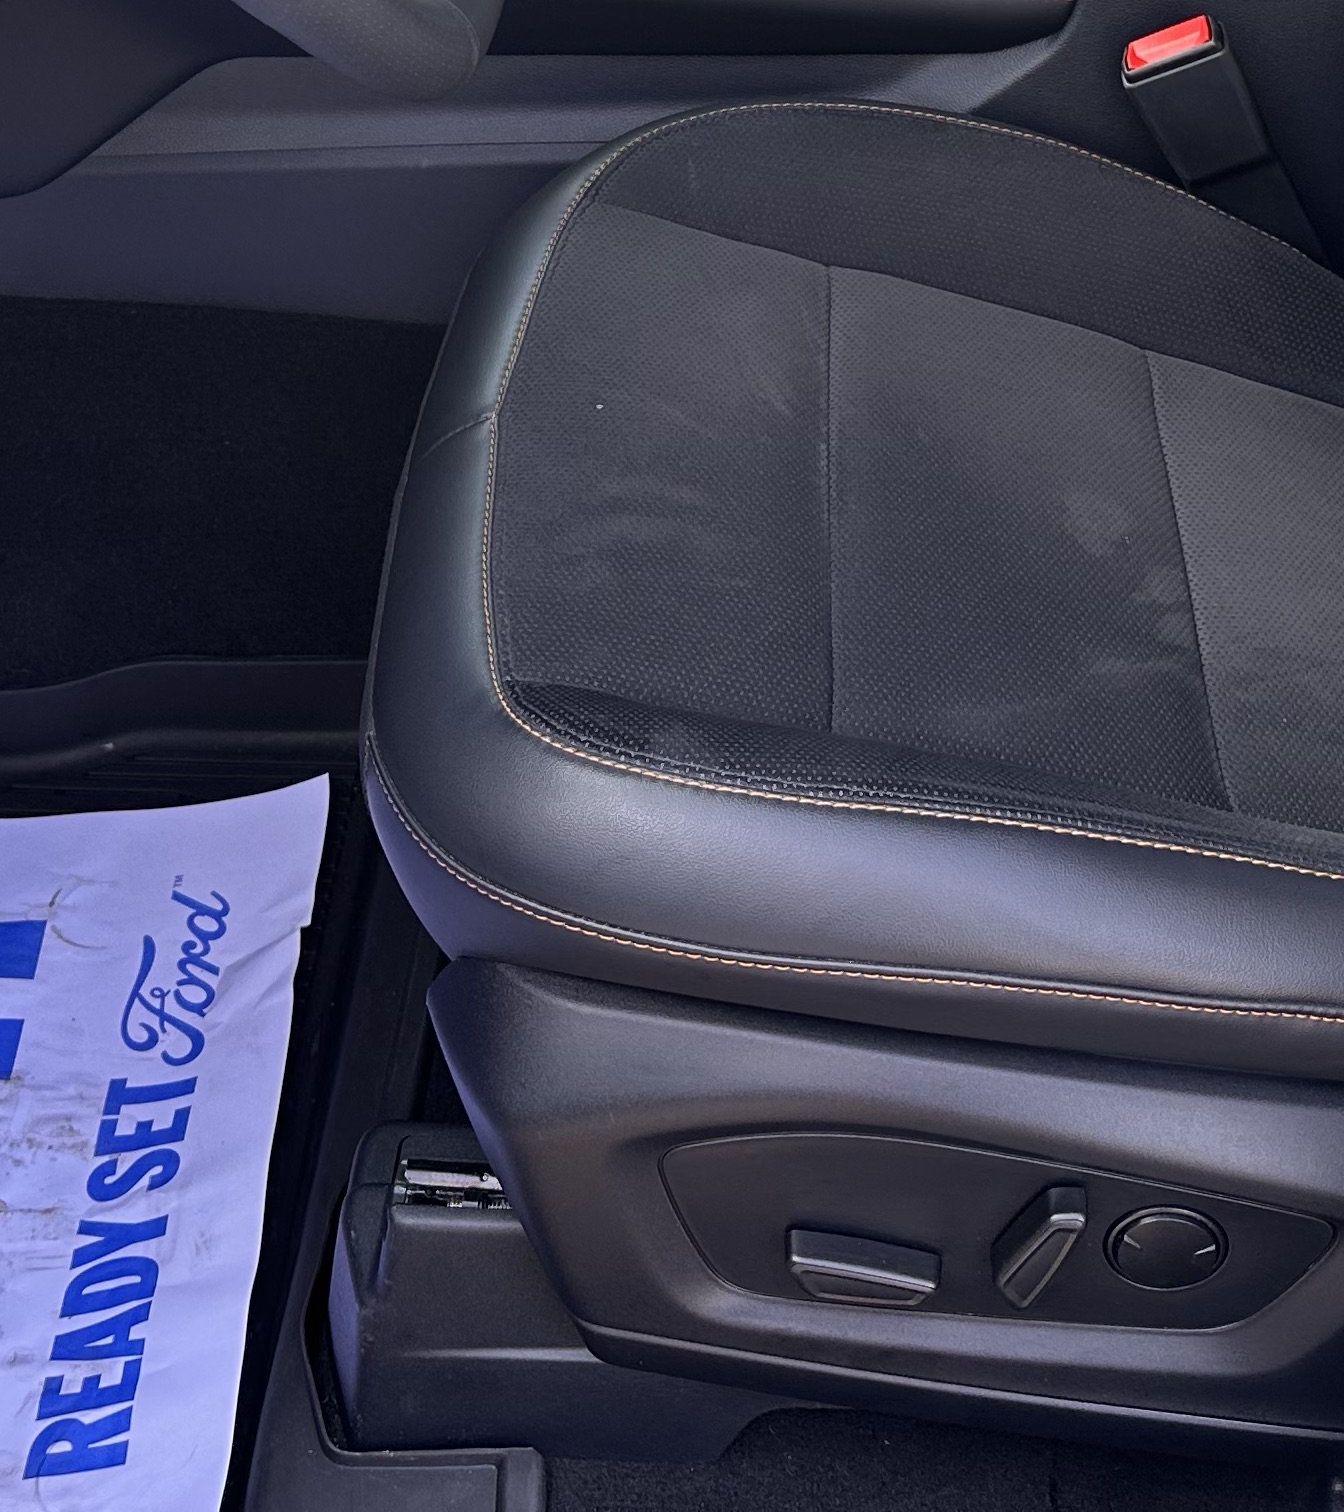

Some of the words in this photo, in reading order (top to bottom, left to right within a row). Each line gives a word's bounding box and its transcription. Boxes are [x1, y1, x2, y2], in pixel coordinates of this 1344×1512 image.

[121, 889, 230, 1066] Ford
[86, 1076, 198, 1202] SET
[22, 1214, 168, 1480] READY
